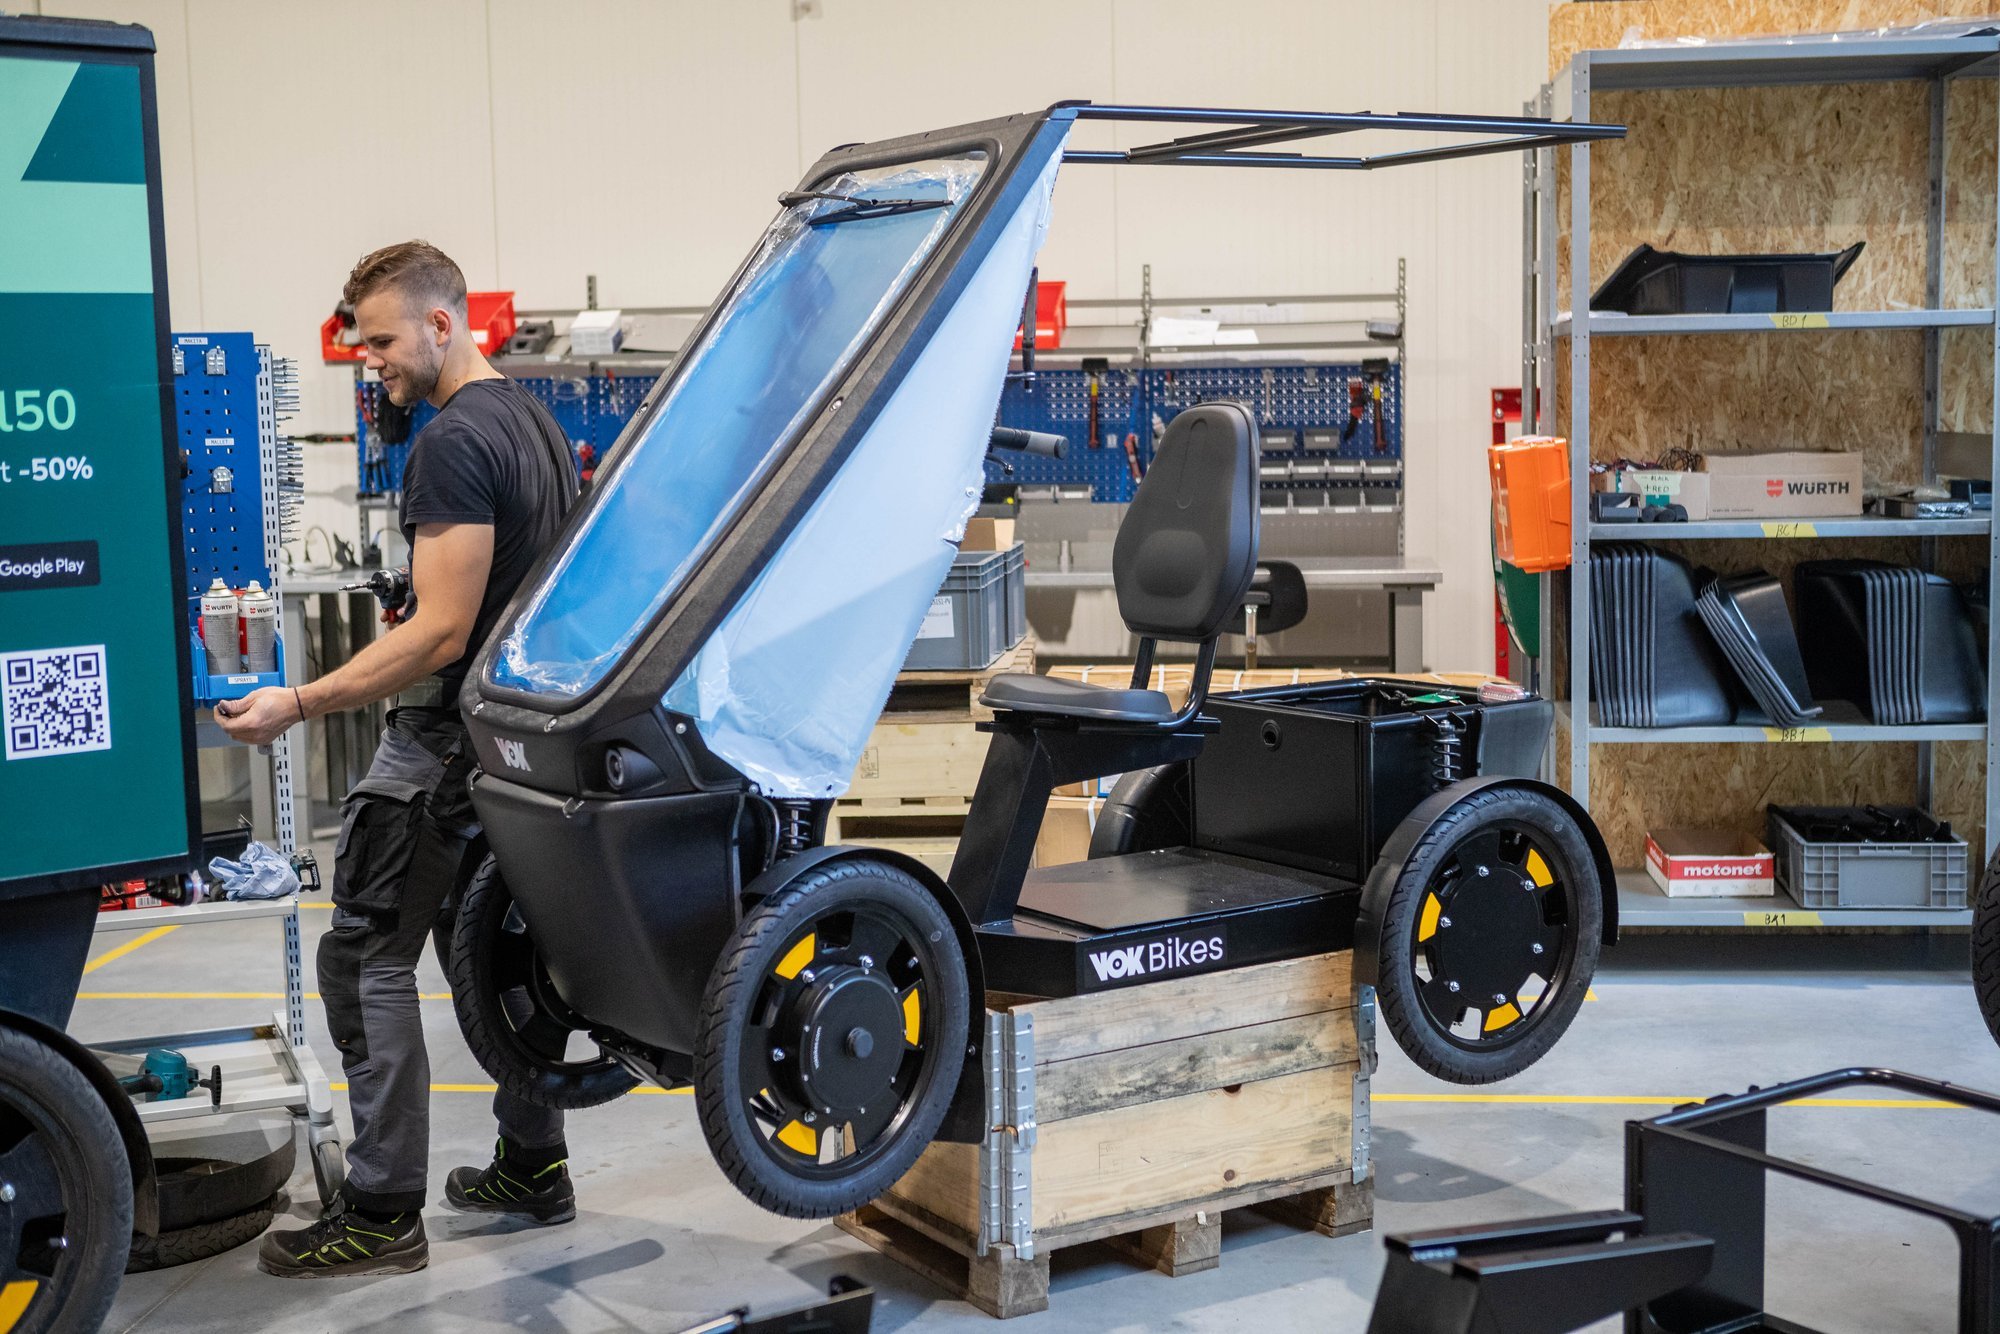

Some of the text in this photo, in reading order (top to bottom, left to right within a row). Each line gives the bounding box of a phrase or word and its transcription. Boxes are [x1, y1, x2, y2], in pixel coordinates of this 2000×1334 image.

[19, 456, 94, 482] -50%
[0, 557, 85, 579] Google Play
[494, 737, 532, 772] VOK
[1683, 863, 1763, 877] motonet
[1089, 936, 1224, 982] VOK Bikes
